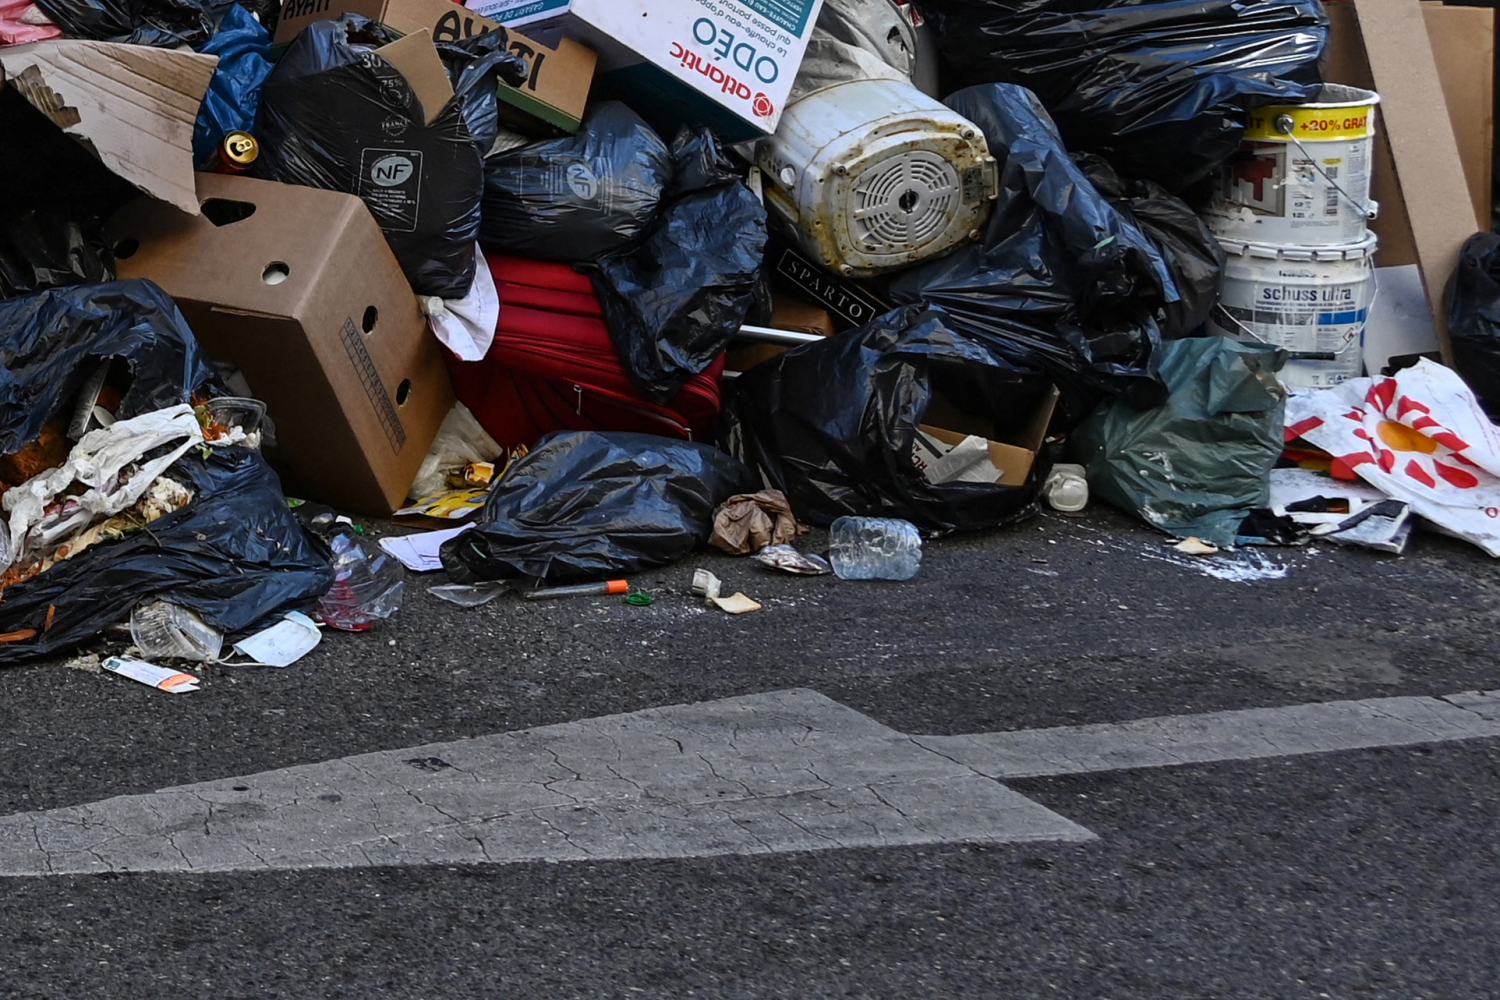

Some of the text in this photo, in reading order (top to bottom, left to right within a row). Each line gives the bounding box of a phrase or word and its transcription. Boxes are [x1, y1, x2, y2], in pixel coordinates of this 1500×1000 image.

[750, 16, 778, 37] passe
[753, 1, 797, 32] CHAUFFE-EAU
[723, 13, 777, 51] chauffe-eau
[775, 32, 792, 47] qui
[433, 10, 545, 91] ATI
[693, 19, 778, 81] ODÉO
[775, 45, 788, 58] Le
[669, 40, 751, 102] atlantic
[1299, 120, 1341, 131] +20%
[376, 161, 410, 179] NF
[572, 167, 592, 197] NF
[788, 261, 864, 319] SPARTO
[1263, 285, 1318, 301] schuss
